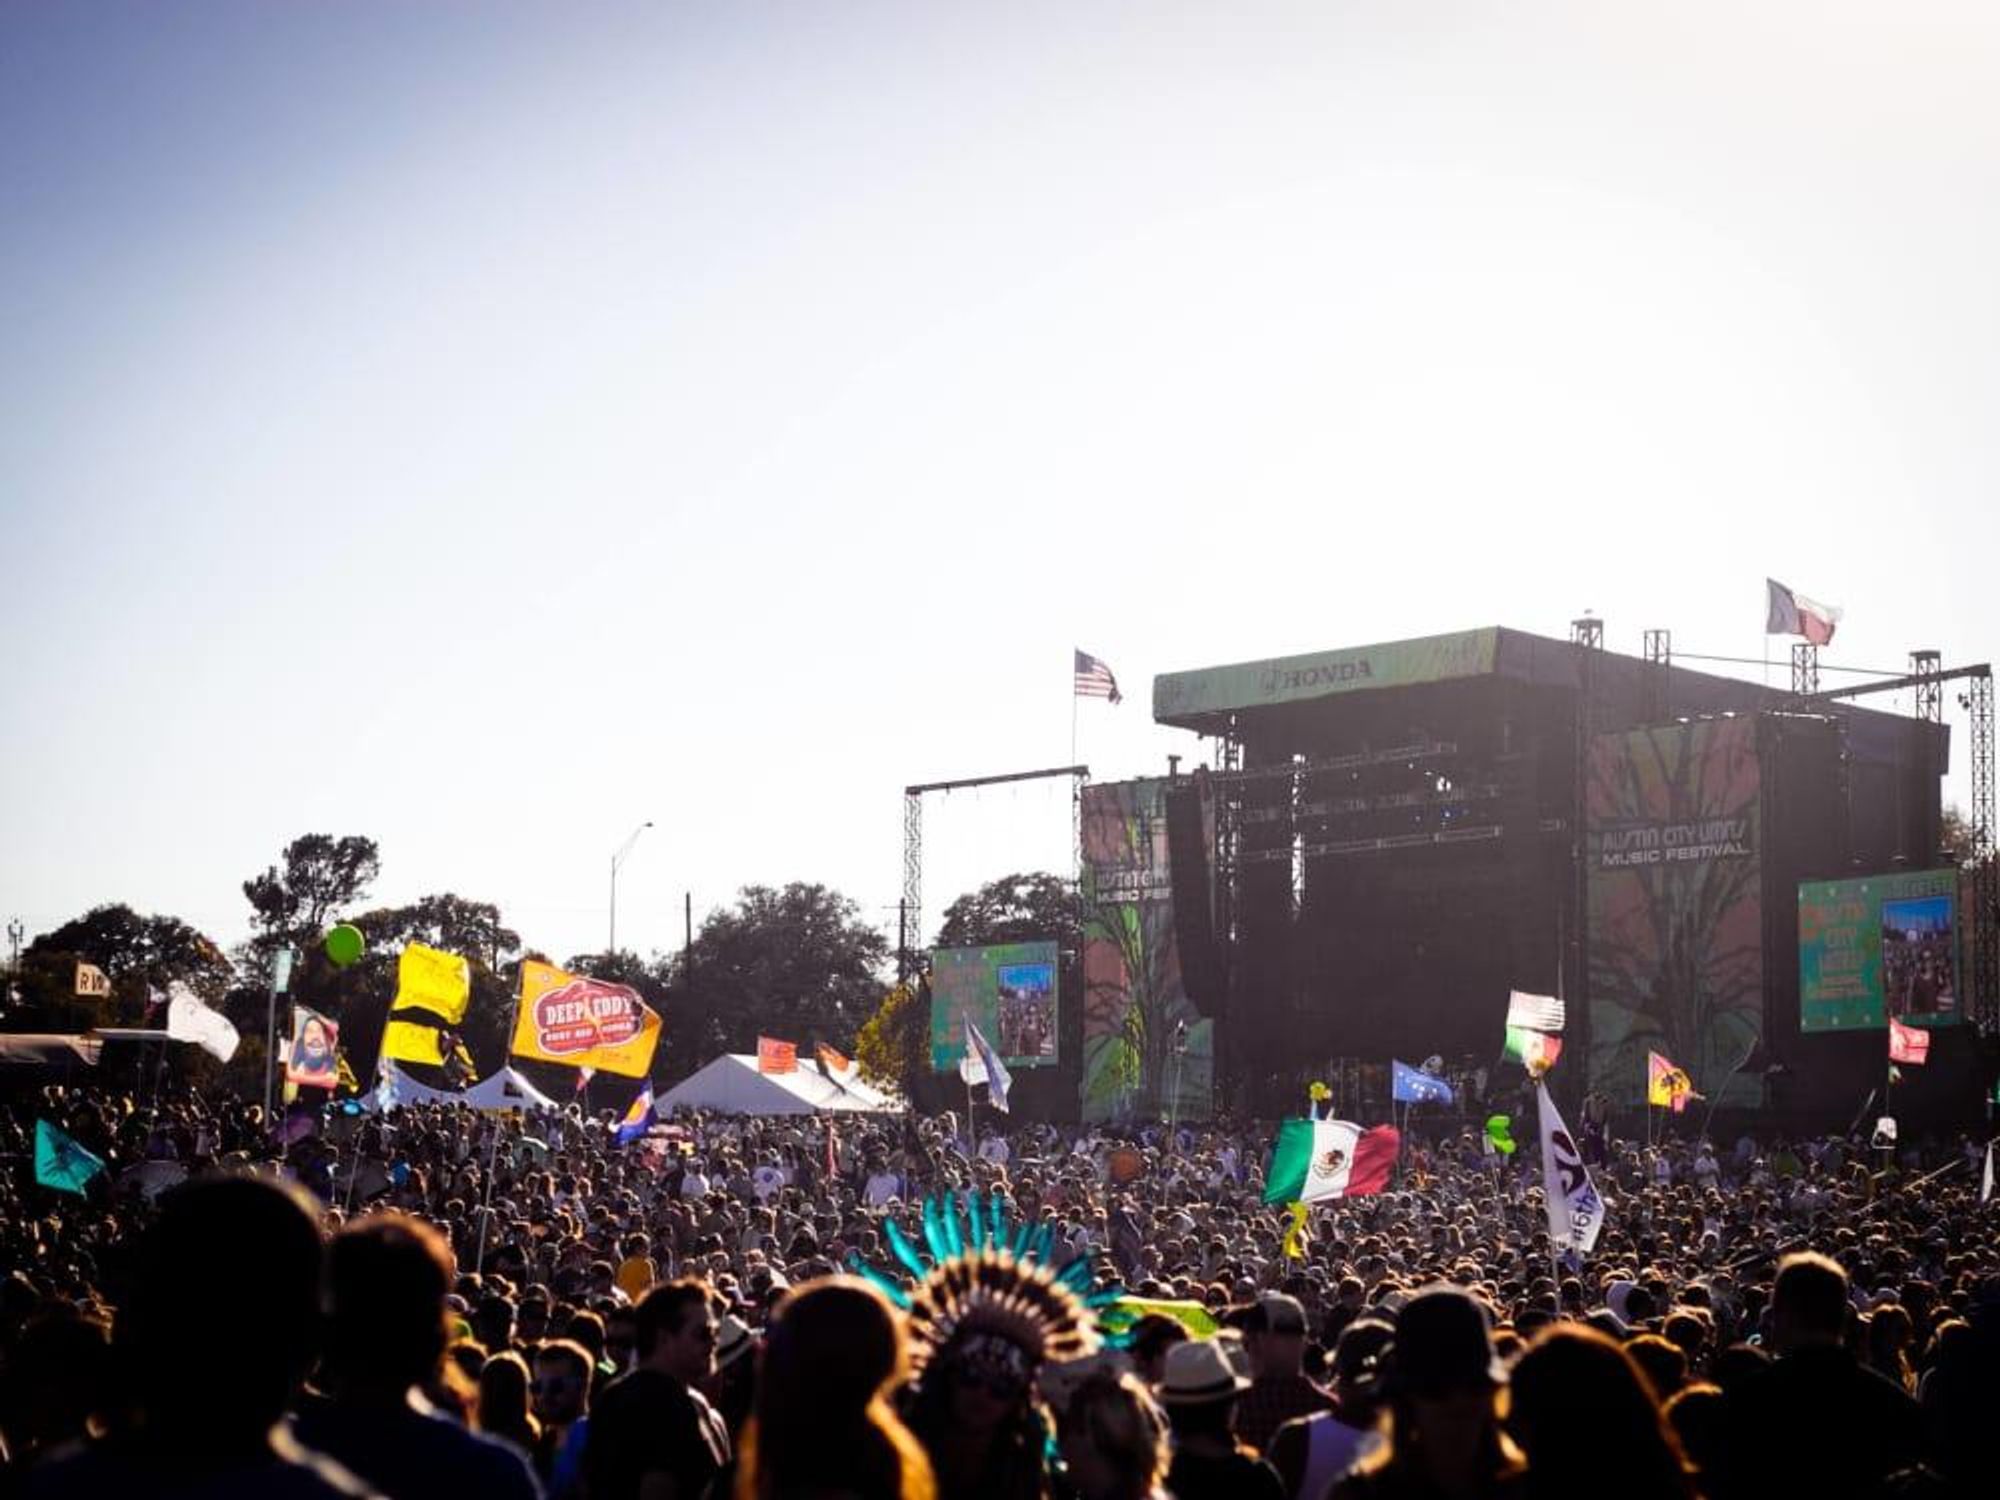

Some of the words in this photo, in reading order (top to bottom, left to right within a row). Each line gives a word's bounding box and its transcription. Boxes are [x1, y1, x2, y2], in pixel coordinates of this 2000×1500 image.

[1283, 660, 1372, 689] HONDA
[1602, 828, 1660, 852] AUSTIN
[1663, 825, 1696, 846] CITY
[1602, 850, 1661, 866] MUSIC
[1666, 842, 1751, 861] FESTIVAL
[545, 1001, 584, 1026] DEEP
[592, 995, 632, 1018] EDDY
